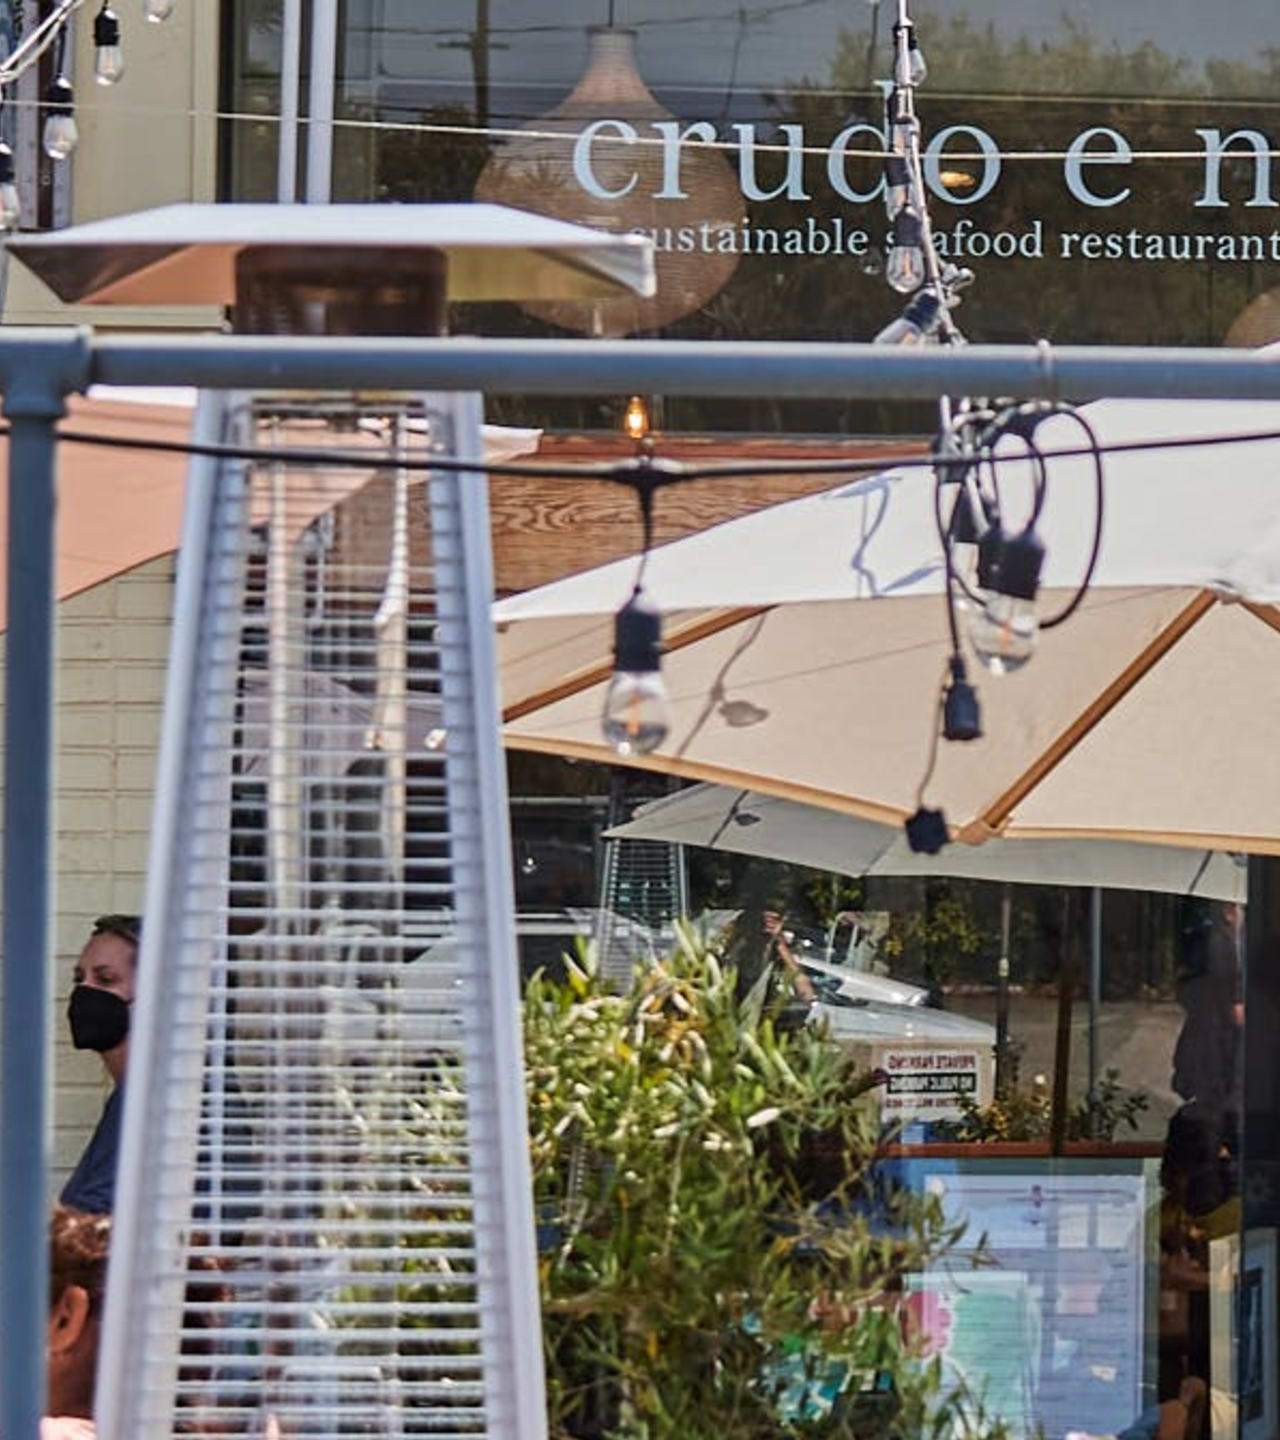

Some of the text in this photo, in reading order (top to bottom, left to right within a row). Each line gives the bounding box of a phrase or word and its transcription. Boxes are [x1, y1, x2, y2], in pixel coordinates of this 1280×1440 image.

[573, 79, 1002, 204] crudo
[1063, 125, 1133, 207] e
[886, 220, 1044, 258] safood
